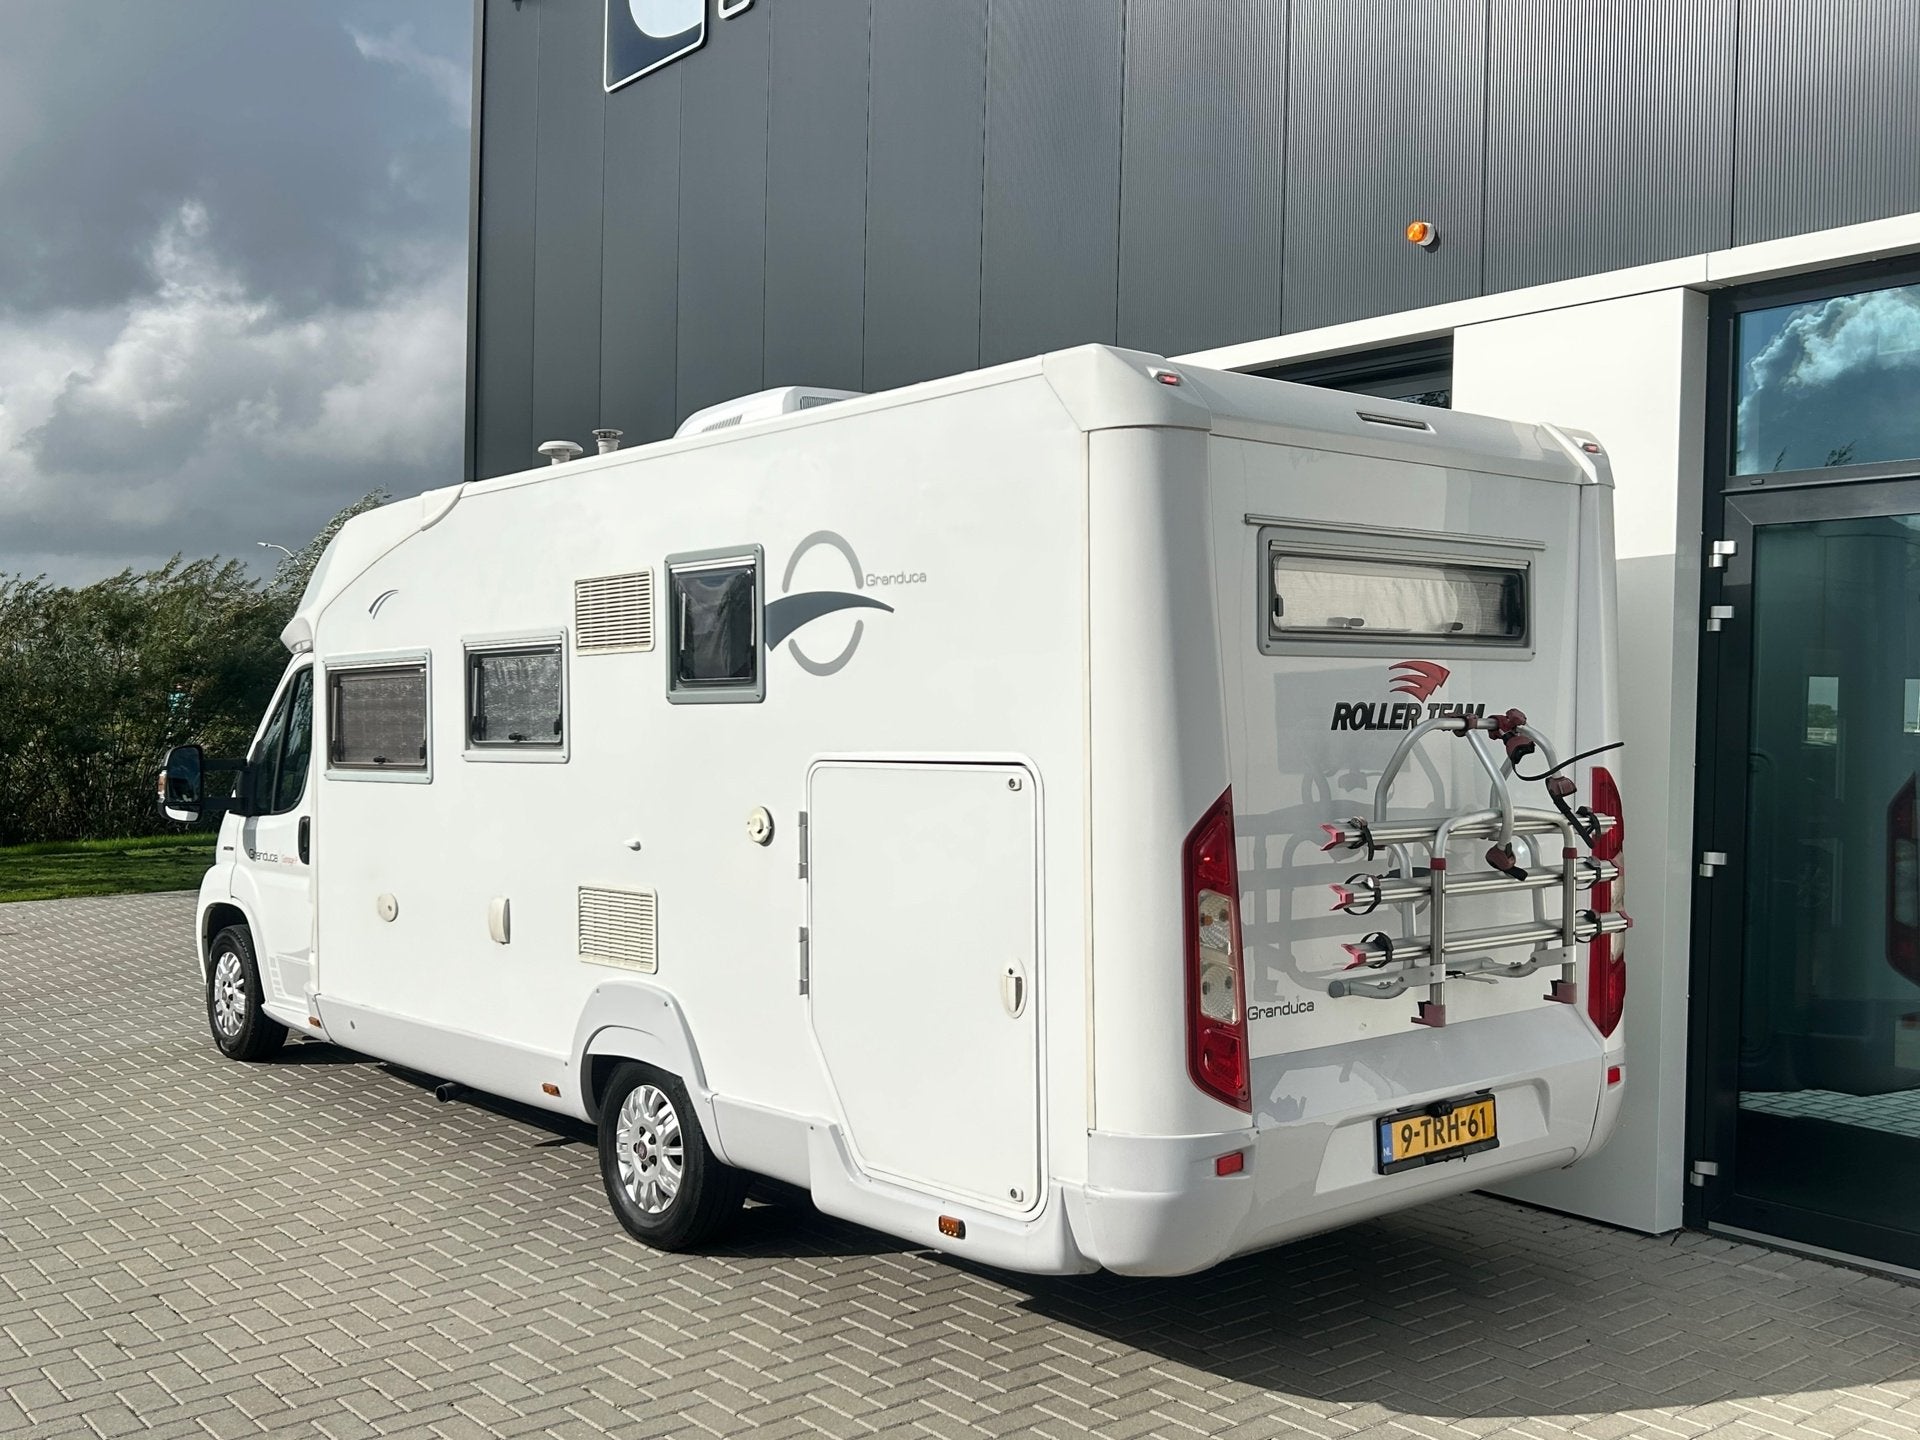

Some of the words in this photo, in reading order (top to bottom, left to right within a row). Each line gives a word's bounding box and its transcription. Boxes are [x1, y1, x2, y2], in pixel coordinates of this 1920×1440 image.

[865, 571, 927, 587] Granduca
[1331, 702, 1422, 731] ROLLER
[1247, 1001, 1315, 1021] Granduca
[1401, 1106, 1486, 1153] 9-TRH-61
[1383, 1147, 1392, 1157] NL
